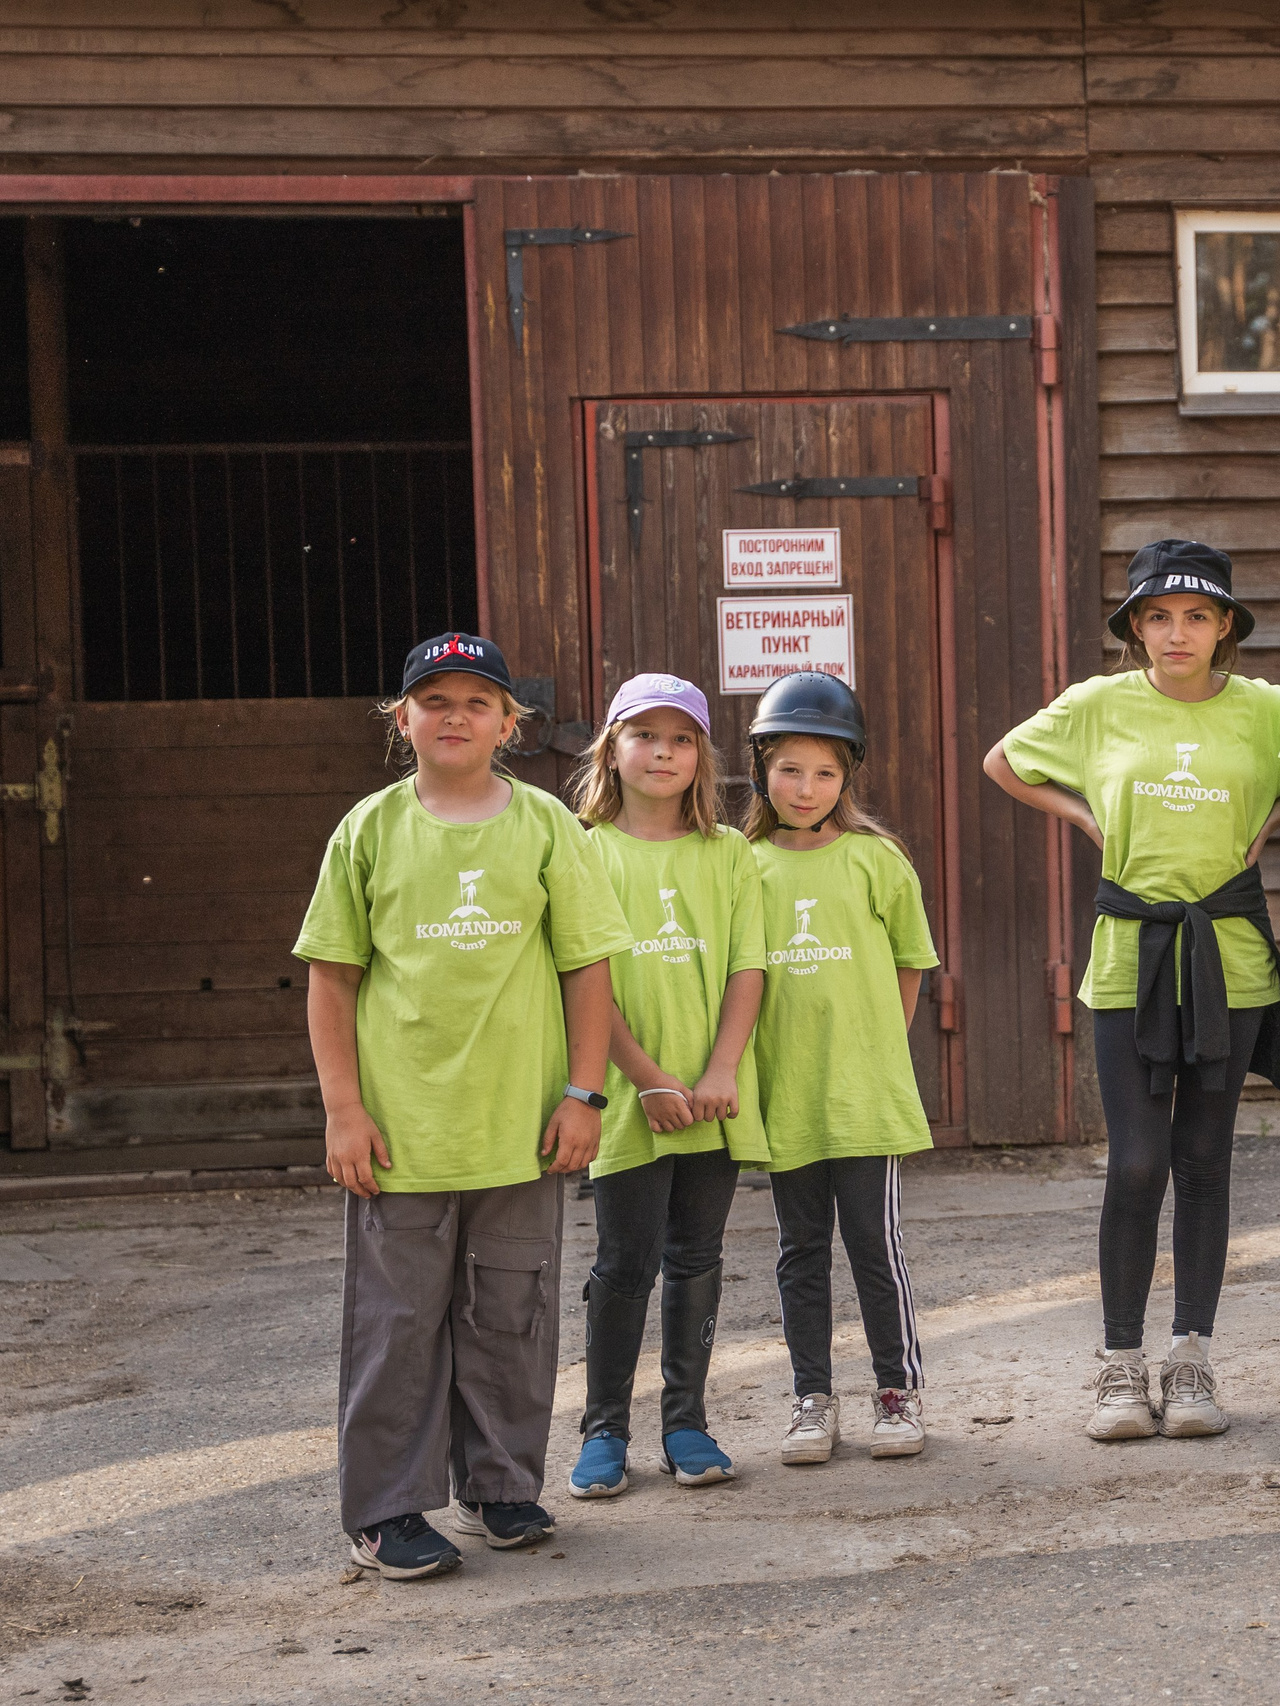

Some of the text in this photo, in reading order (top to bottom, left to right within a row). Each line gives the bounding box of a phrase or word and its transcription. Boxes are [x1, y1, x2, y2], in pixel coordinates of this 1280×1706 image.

[739, 538, 825, 554] ПОСТОРОННИМ
[731, 560, 834, 577] ВХОД ЗАПРЕЩЕН!
[725, 605, 845, 630] ВЕТЕРИНАРНЫЙ
[761, 635, 811, 654] ПУНКТ
[728, 661, 846, 679] КАРАНТИННЫЙ БЛОК
[1133, 780, 1230, 803] KOMANDOR
[1161, 800, 1196, 812] camp
[415, 920, 522, 939] KOMANDOR
[450, 938, 487, 951] camp
[787, 963, 819, 975] camp
